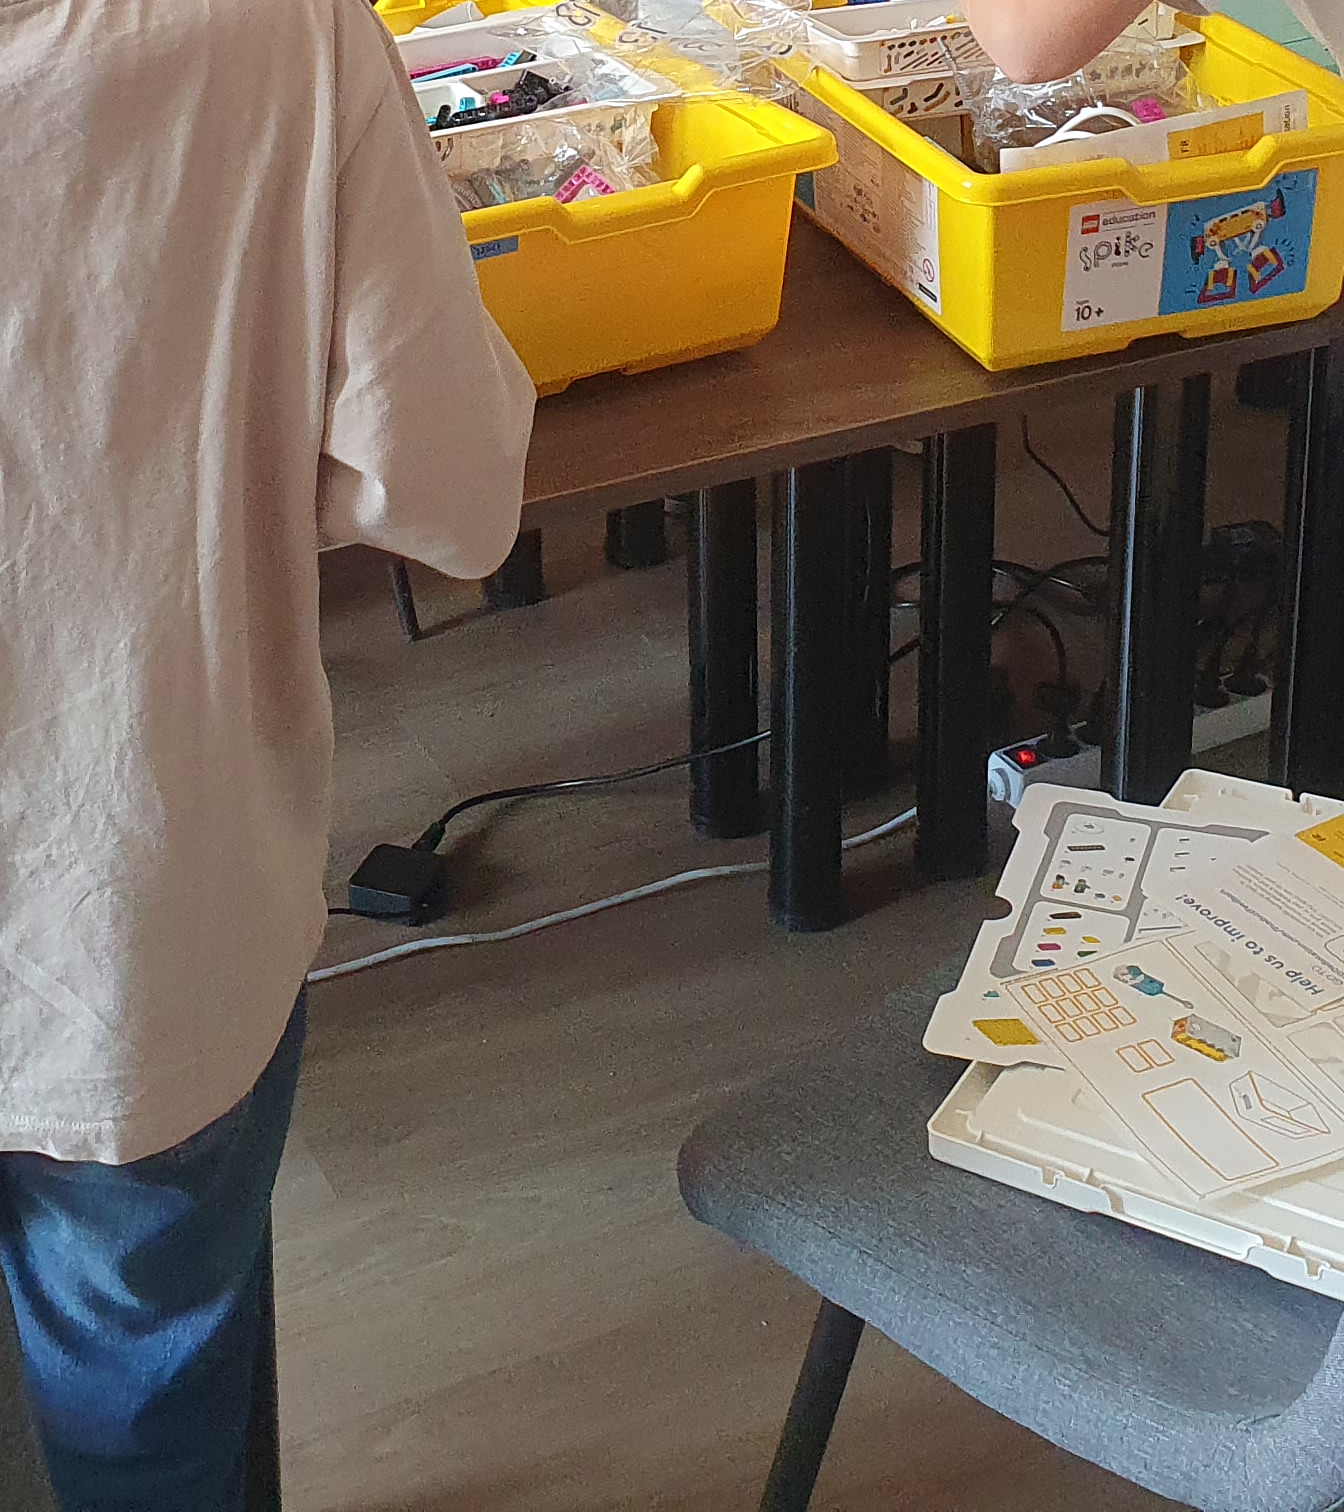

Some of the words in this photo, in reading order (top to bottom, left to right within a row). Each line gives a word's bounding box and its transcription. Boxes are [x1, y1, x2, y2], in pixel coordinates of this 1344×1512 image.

[1101, 210, 1156, 228] education
[1078, 230, 1155, 272] spike
[1074, 305, 1104, 322] 10+
[1174, 893, 1245, 944] improve!
[1244, 939, 1262, 957] to
[1263, 953, 1286, 971] us
[1284, 967, 1326, 996] Help
